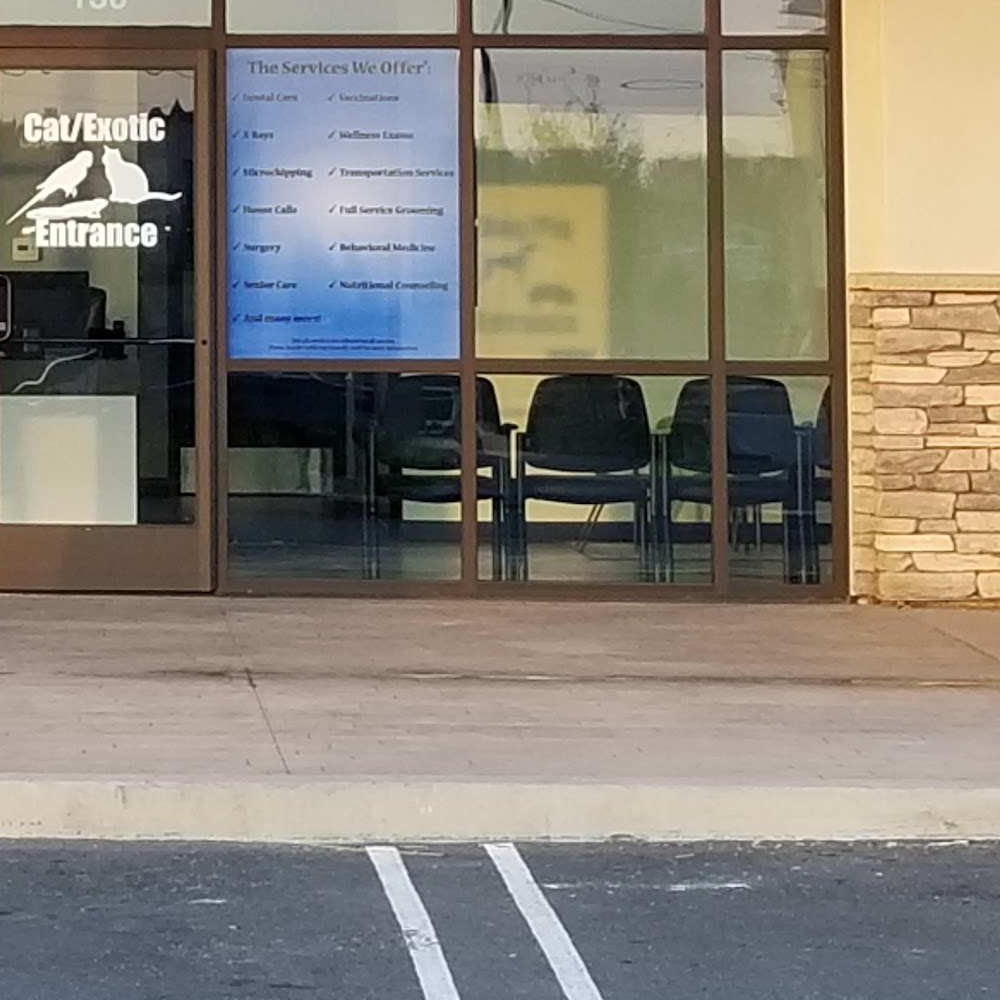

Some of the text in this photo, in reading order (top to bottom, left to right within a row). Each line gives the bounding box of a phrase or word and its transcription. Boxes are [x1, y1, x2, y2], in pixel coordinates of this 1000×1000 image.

[248, 60, 279, 75] The
[282, 61, 349, 75] Services
[352, 60, 377, 75] We
[23, 112, 167, 143] Cat/Exotic
[339, 130, 381, 140] Wellness
[243, 167, 313, 179] Microchipping
[340, 168, 454, 179] Transportation Services
[339, 205, 444, 217] Full Service Grooming
[35, 218, 159, 248] Entrance
[340, 242, 436, 252] Behavioral Medicine
[340, 280, 394, 290] Nutritional
